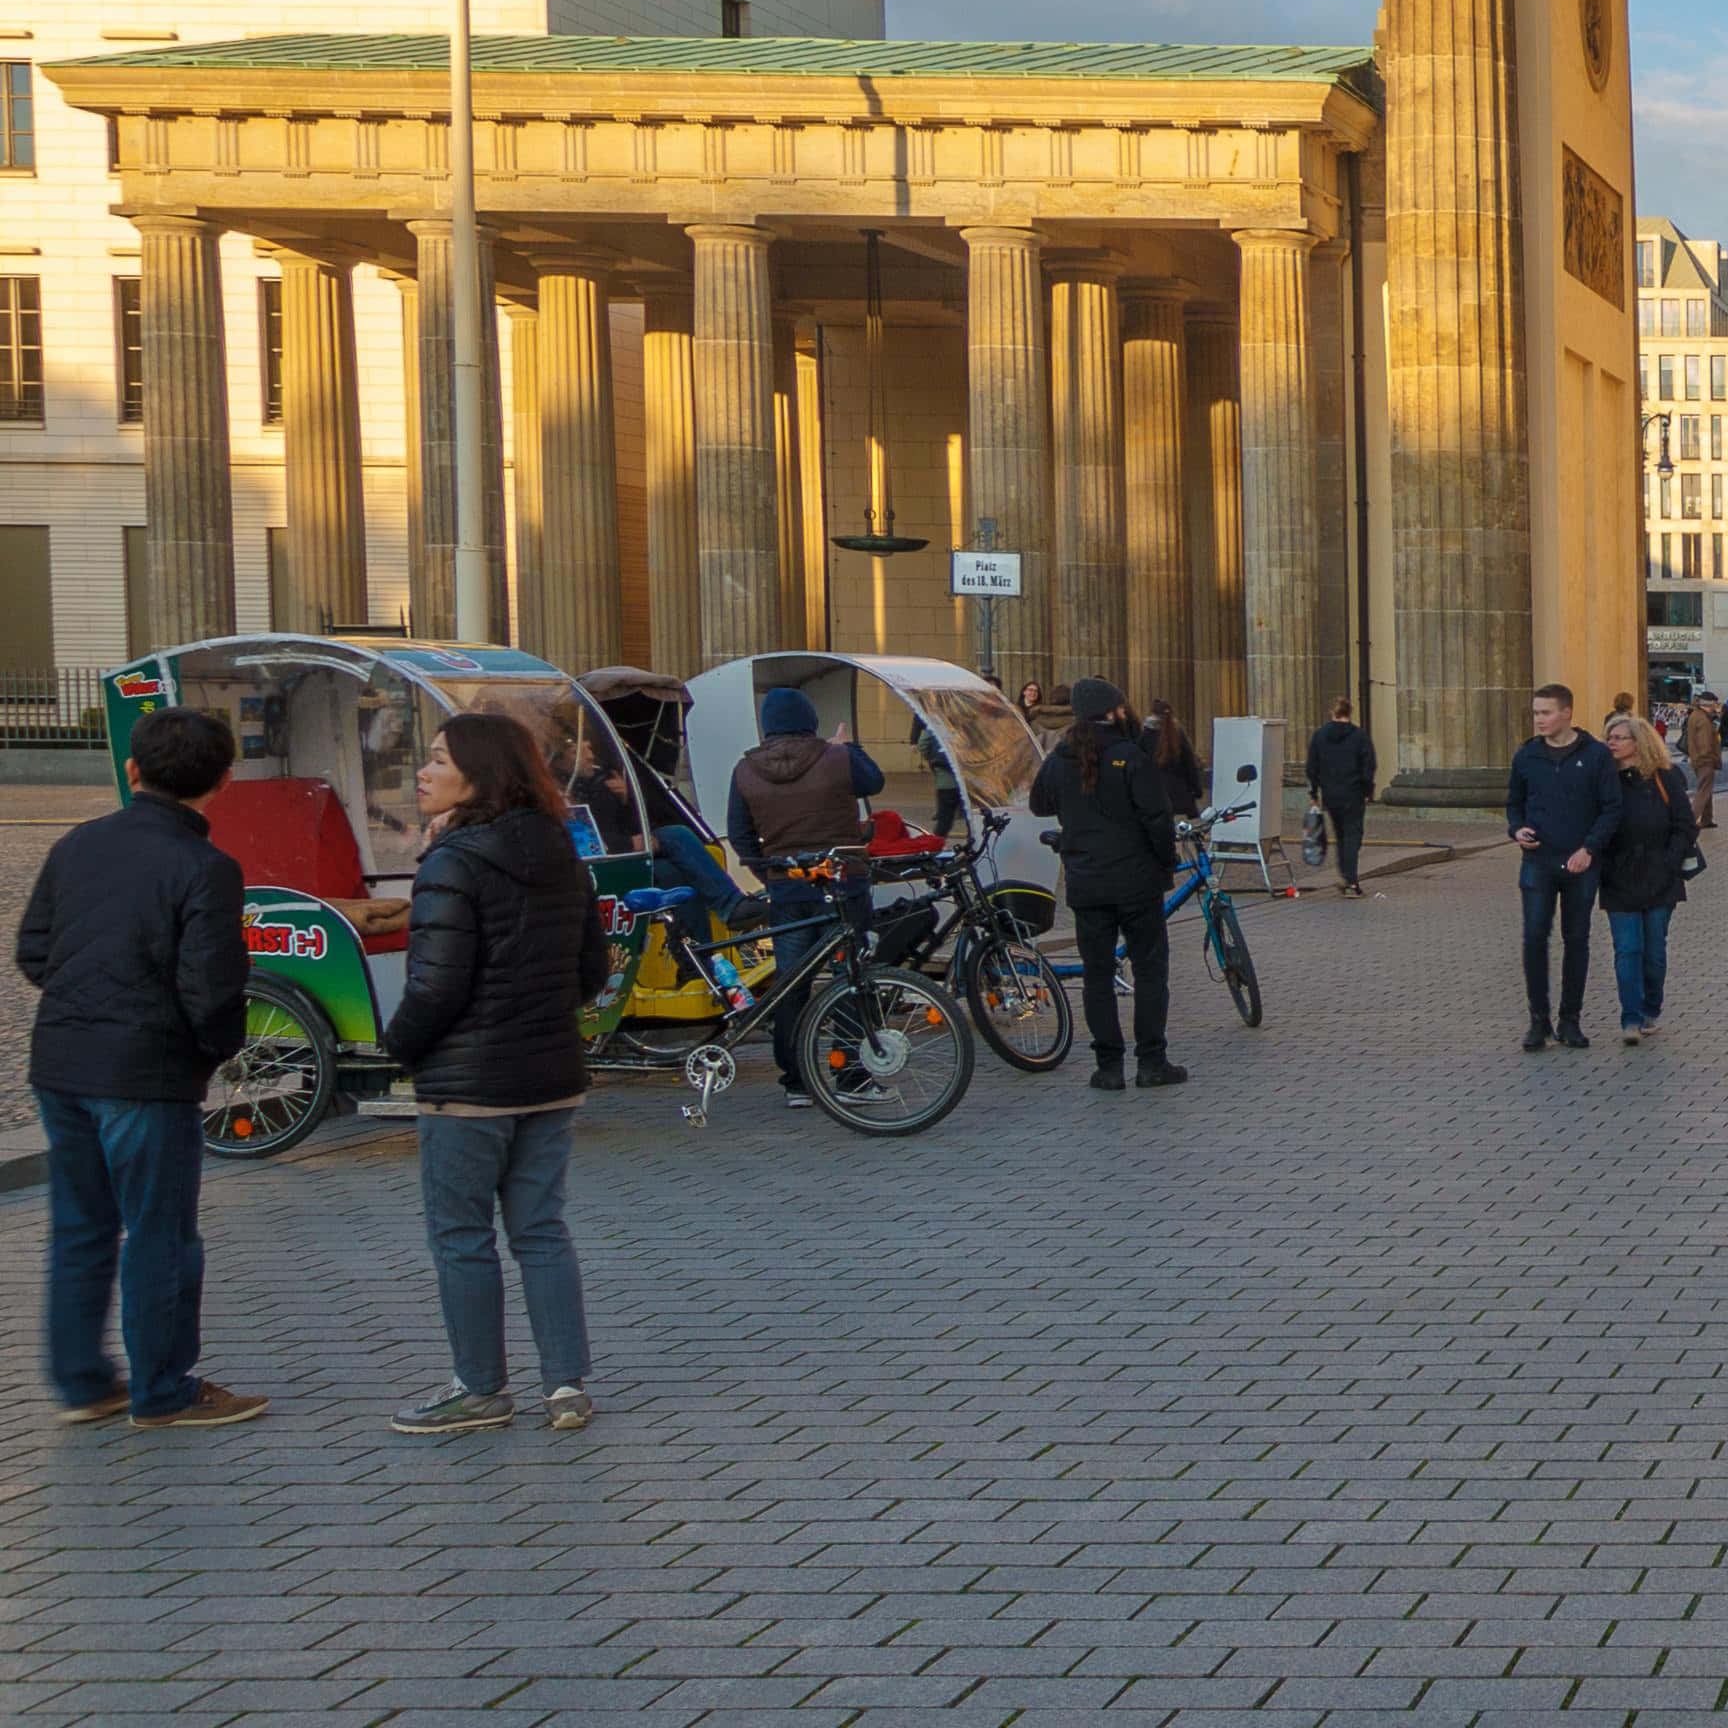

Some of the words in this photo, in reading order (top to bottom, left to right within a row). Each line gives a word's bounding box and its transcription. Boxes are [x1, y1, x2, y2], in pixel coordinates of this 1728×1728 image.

[975, 560, 997, 572] Platz
[962, 575, 976, 587] des
[977, 575, 989, 587] 18.
[990, 575, 1012, 588] März
